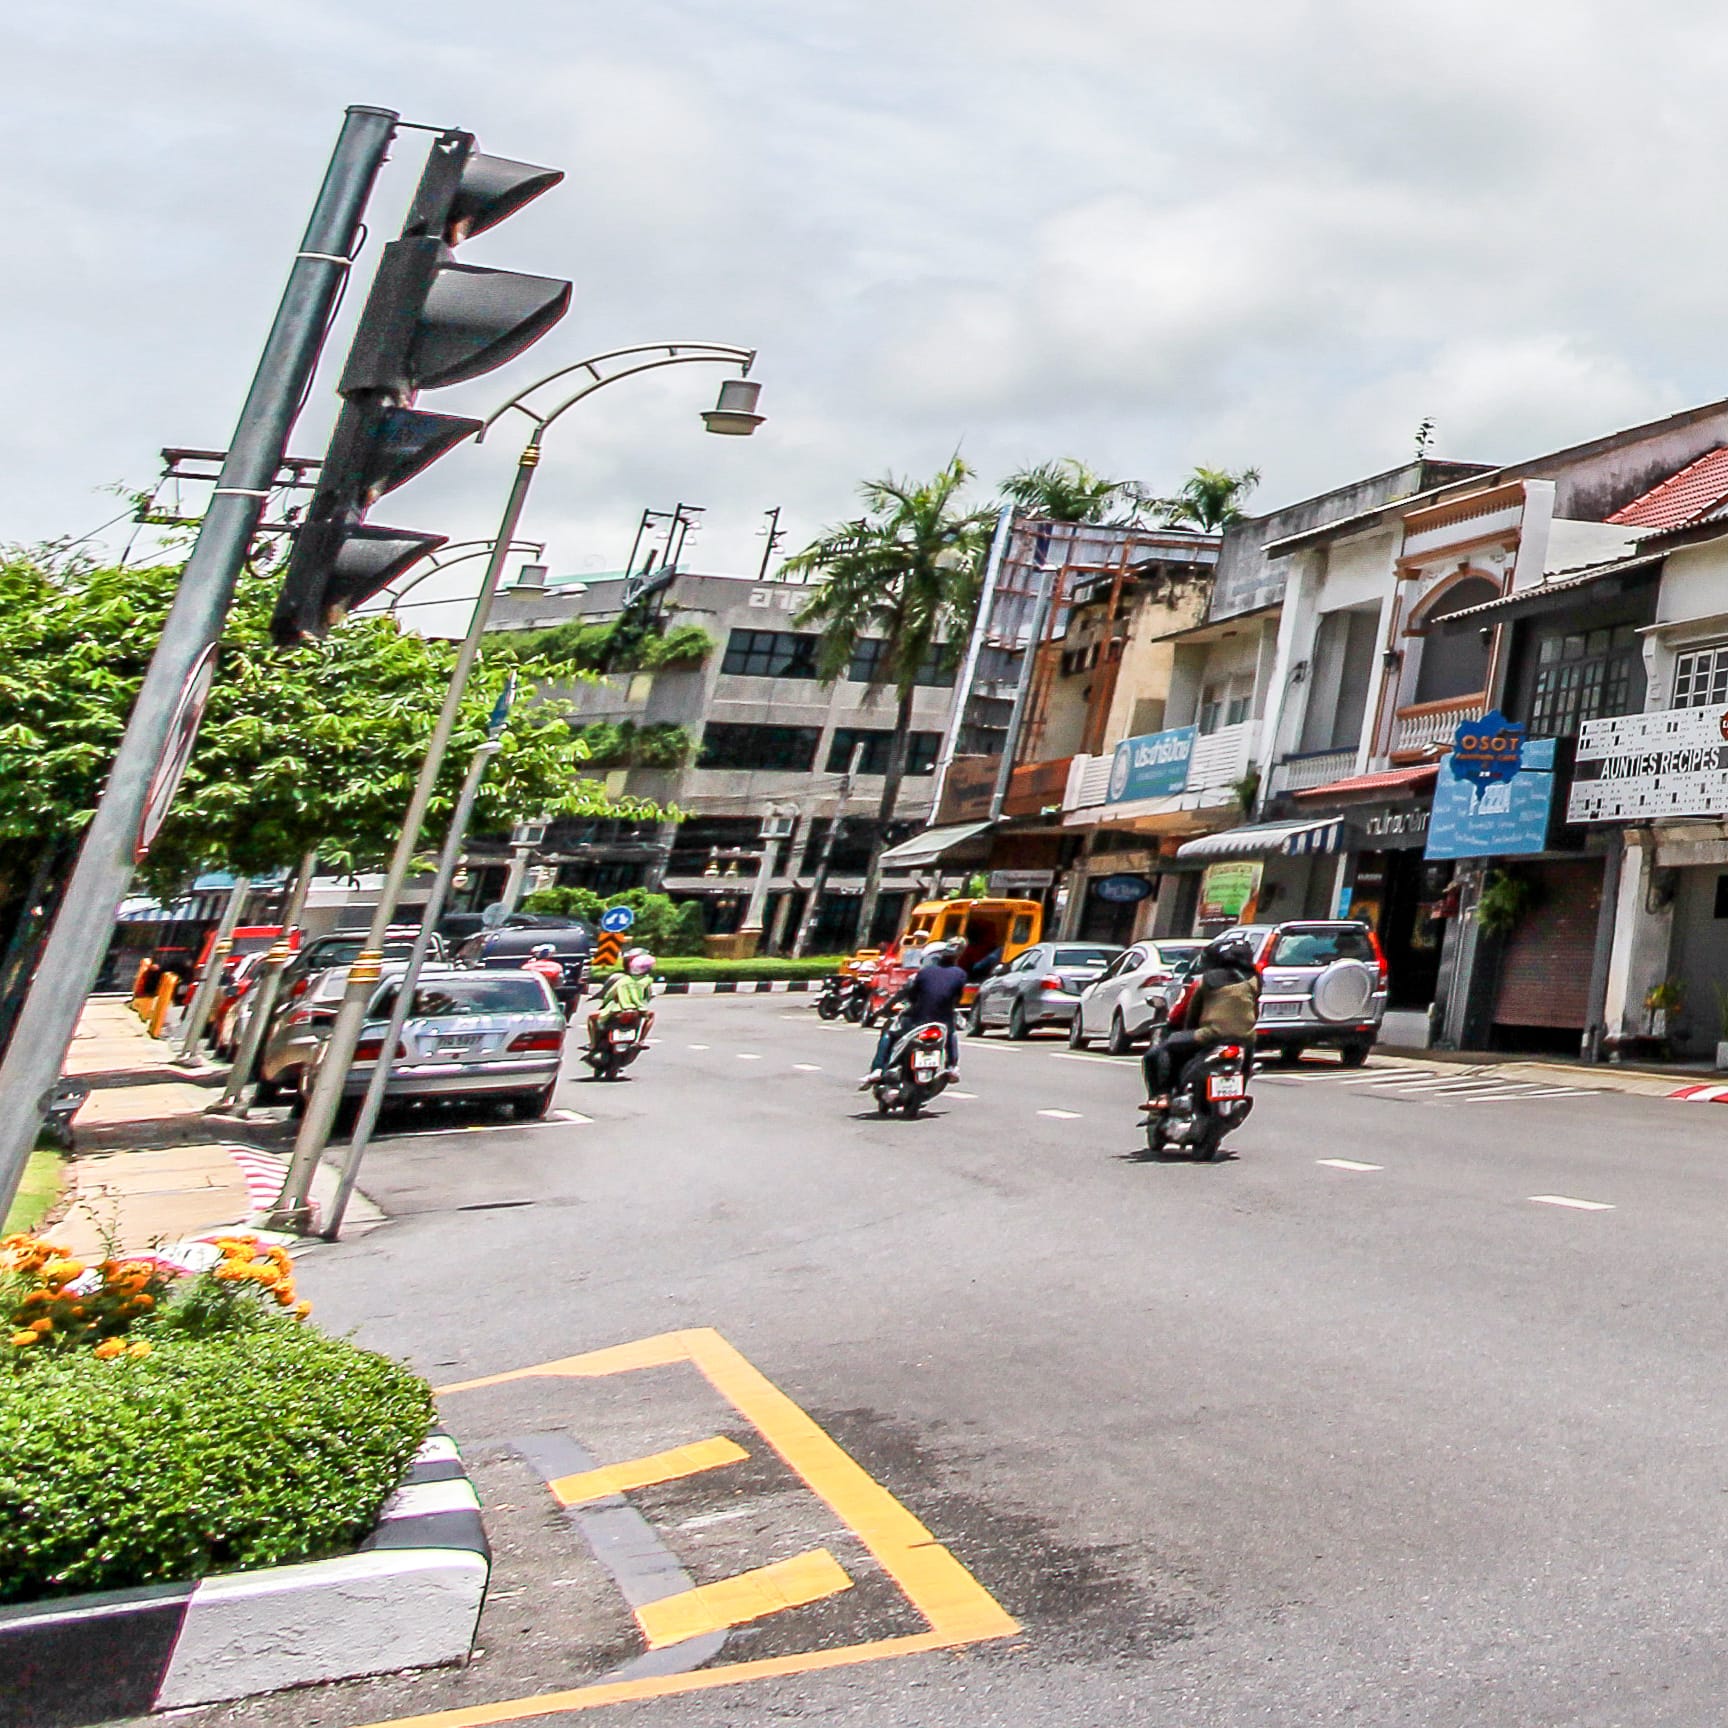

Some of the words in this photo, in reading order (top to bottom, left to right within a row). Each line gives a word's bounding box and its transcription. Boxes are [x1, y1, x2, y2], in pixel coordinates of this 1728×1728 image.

[1461, 735, 1519, 751] OSOT
[1600, 752, 1658, 780] AUNTIES
[1659, 747, 1720, 775] RECIPES
